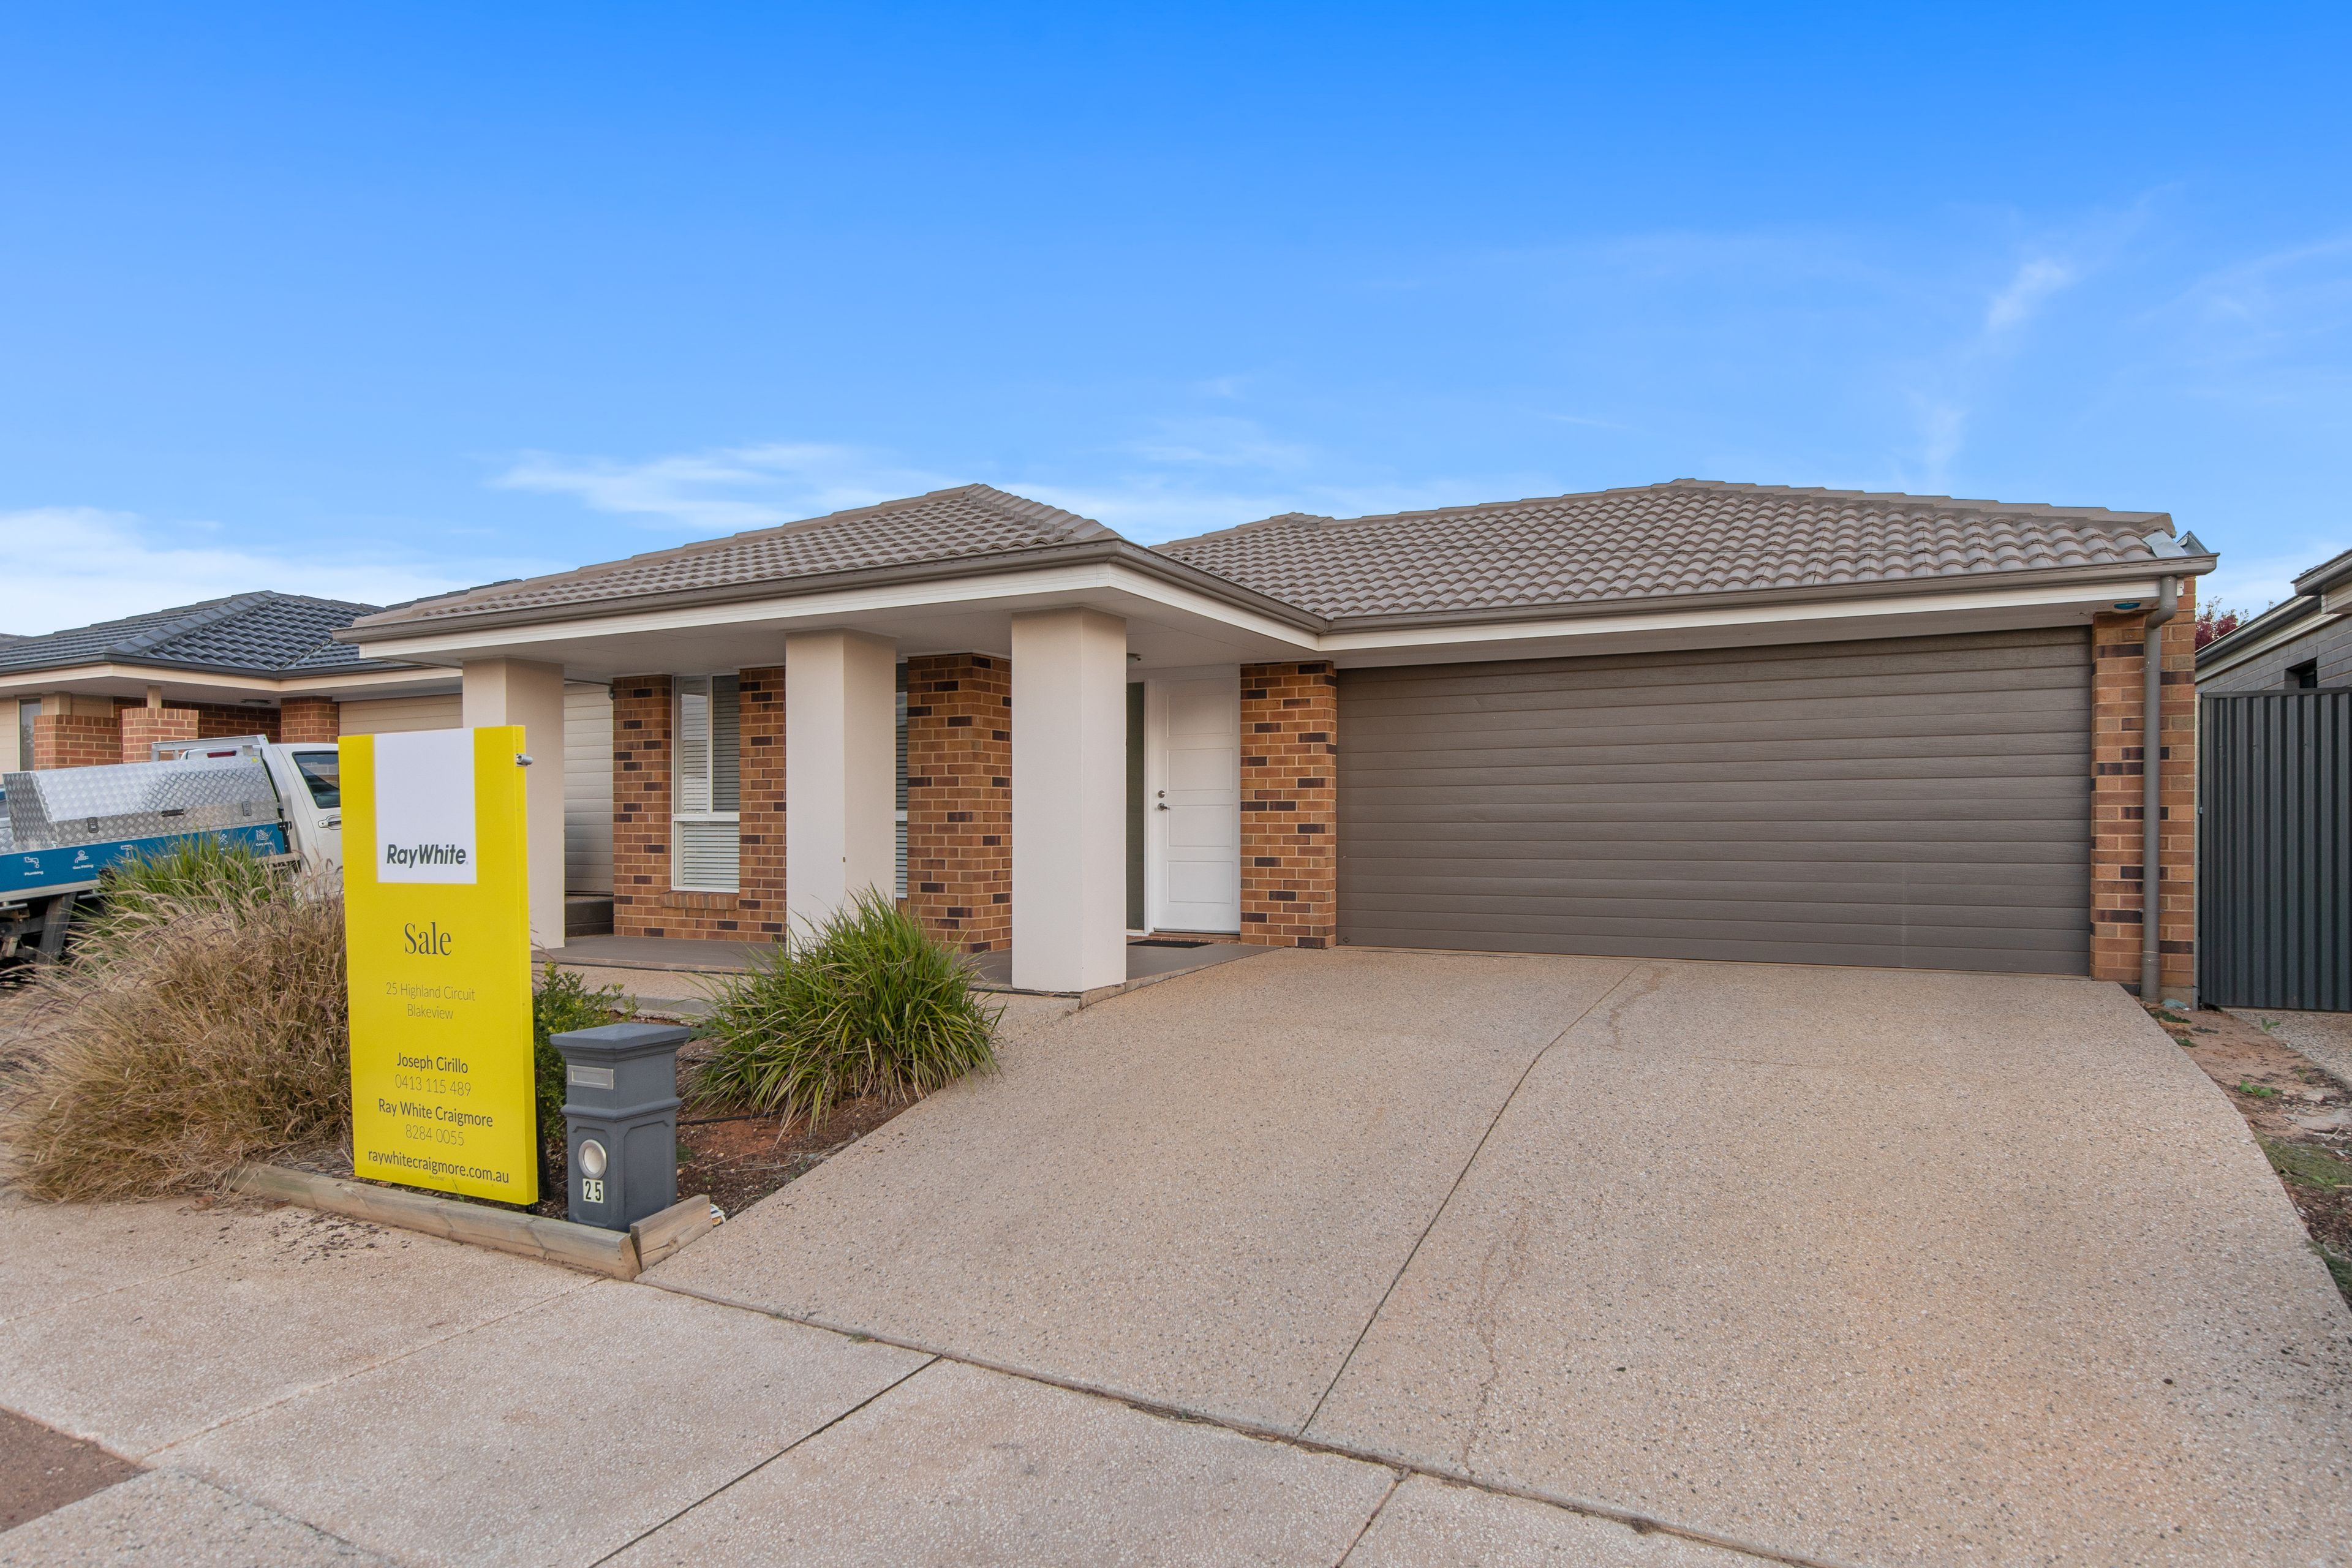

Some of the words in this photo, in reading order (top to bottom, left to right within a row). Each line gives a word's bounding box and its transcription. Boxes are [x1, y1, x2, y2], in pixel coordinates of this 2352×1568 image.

[386, 843, 467, 869] RayWhite
[404, 921, 452, 956] Sale
[386, 982, 398, 995] 25
[401, 983, 440, 999] Highland
[443, 986, 476, 1001] Circuit
[407, 1003, 454, 1020] Blakeview
[396, 1052, 433, 1072] Joseph
[436, 1056, 469, 1074] Cirillo
[394, 1074, 422, 1091] 0413
[426, 1077, 447, 1094] 115
[450, 1080, 471, 1097] 489
[379, 1098, 398, 1117] Ray
[400, 1101, 432, 1120] White
[435, 1106, 494, 1128] Craigmore
[405, 1123, 433, 1141] 8284
[436, 1128, 464, 1147] 0055
[368, 1150, 510, 1184] raywhitecraigmore.com.au
[585, 1180, 602, 1202] 25
